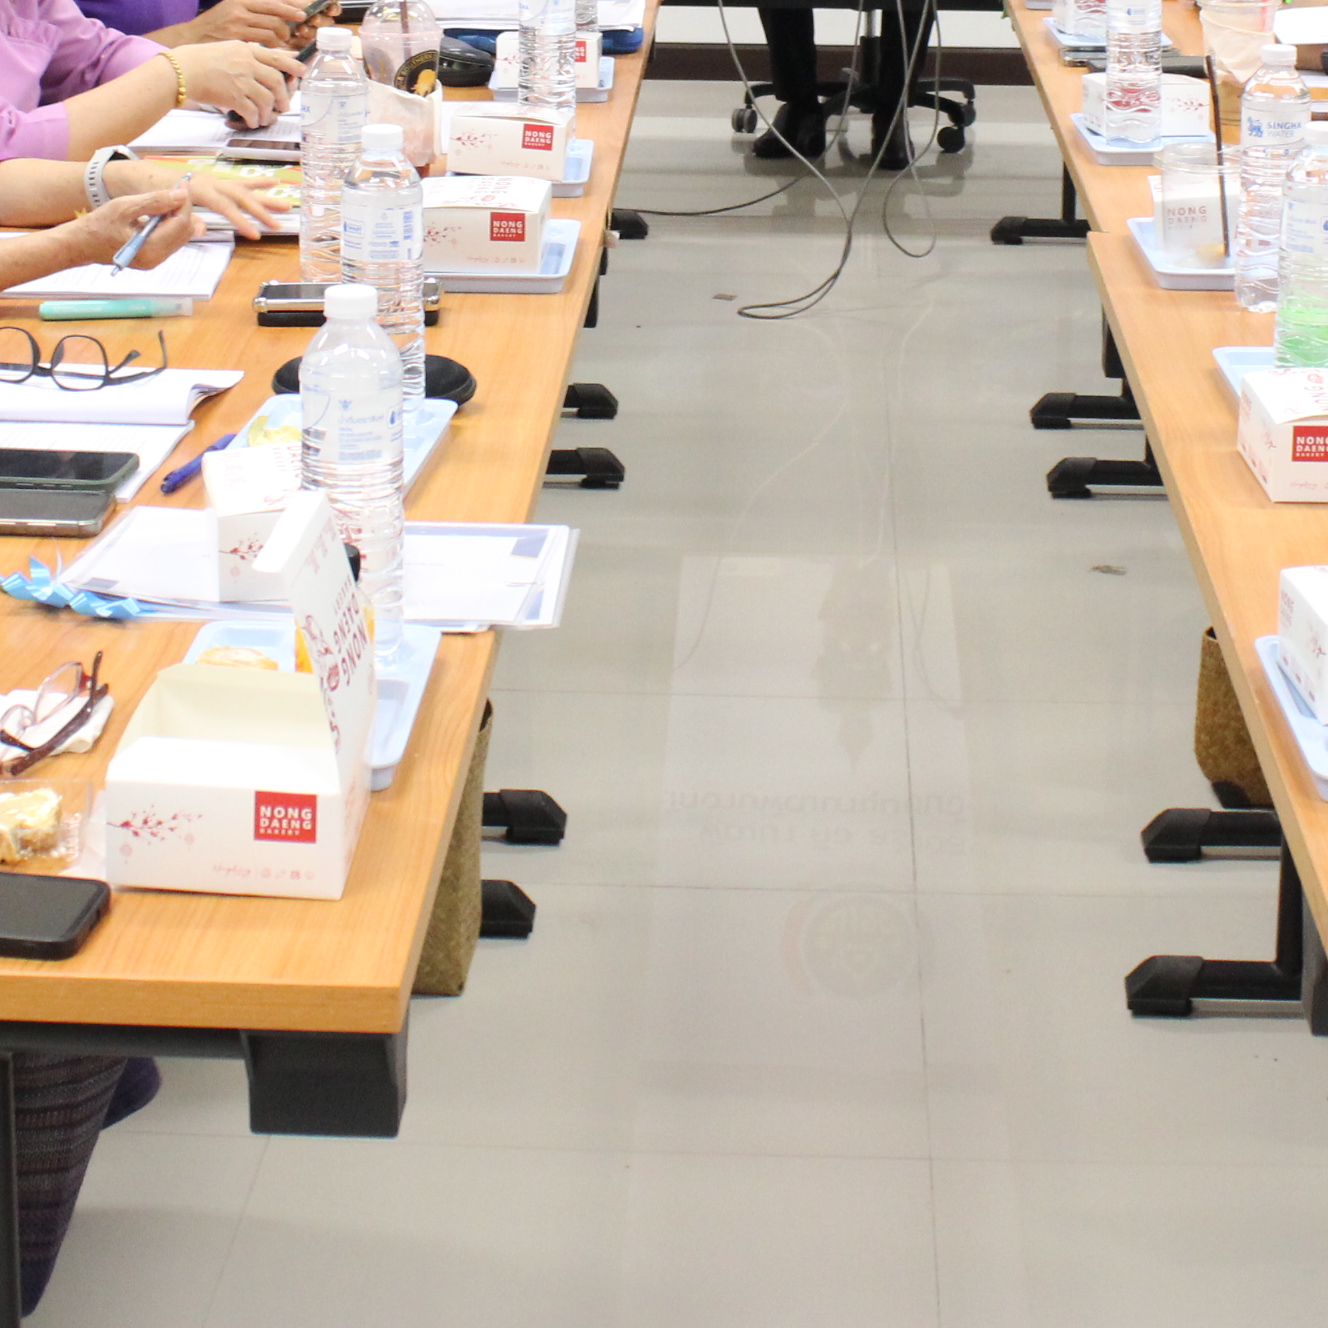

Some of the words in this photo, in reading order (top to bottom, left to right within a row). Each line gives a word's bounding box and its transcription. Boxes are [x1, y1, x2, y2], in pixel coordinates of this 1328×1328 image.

[1267, 121, 1302, 130] SINGHA
[525, 130, 552, 139] NONG
[1167, 206, 1207, 216] NONG
[493, 220, 523, 228] NONG
[341, 621, 368, 686] NONG
[259, 805, 312, 820] NONG
[259, 818, 312, 830] DAENG
